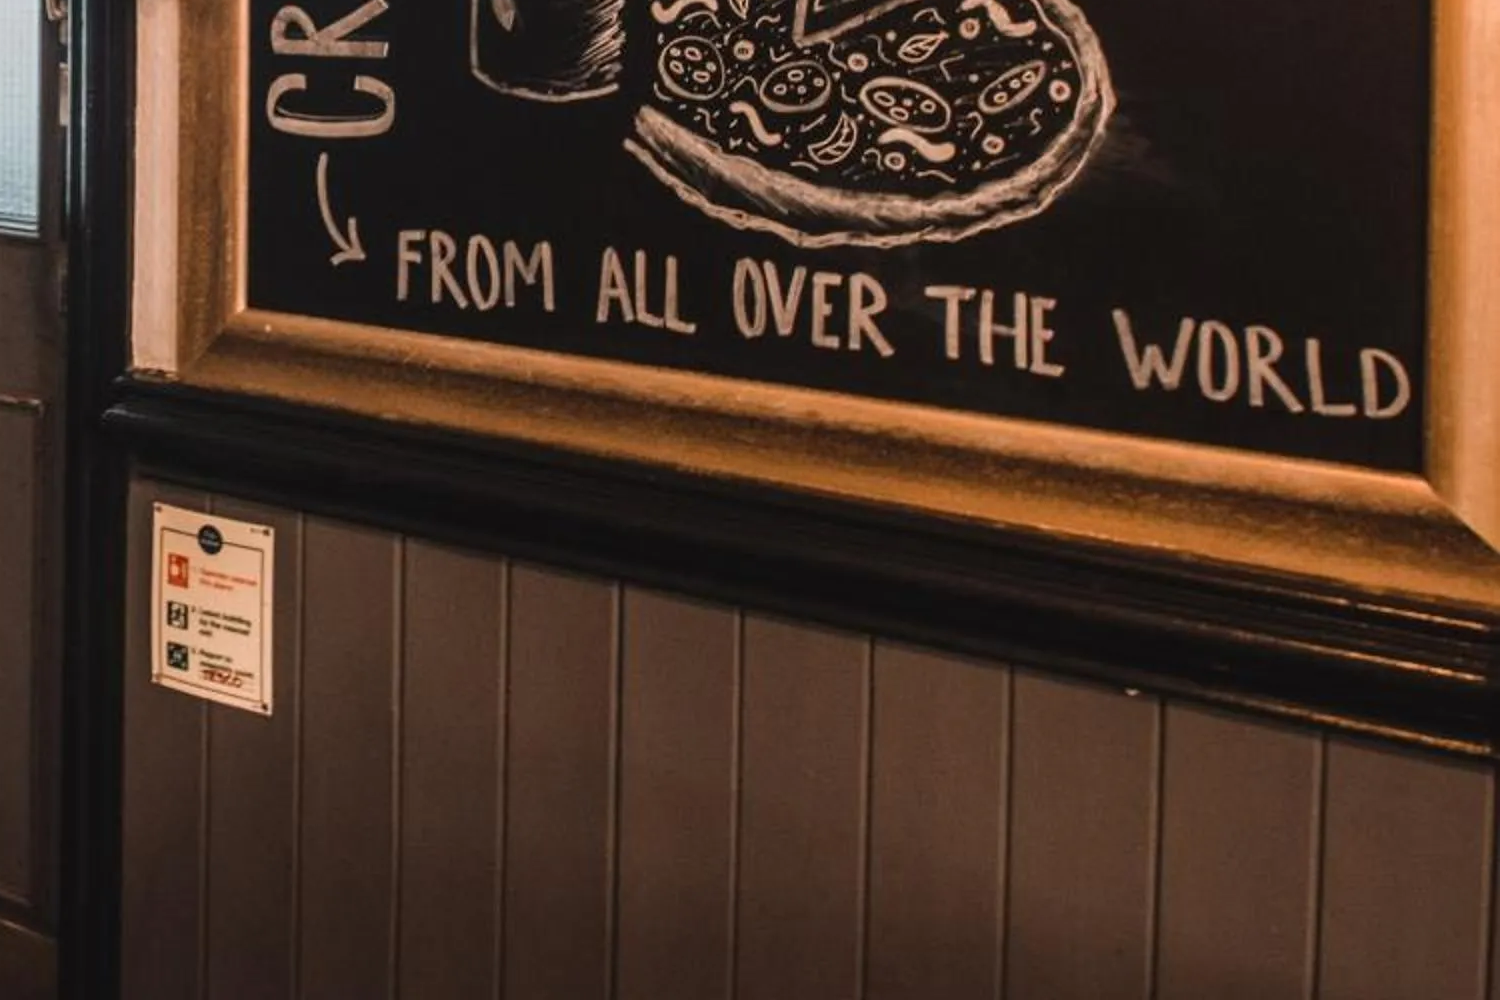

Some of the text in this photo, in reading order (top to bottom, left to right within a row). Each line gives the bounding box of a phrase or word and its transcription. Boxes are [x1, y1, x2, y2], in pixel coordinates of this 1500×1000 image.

[397, 229, 1411, 419] FROM ALL OVER THE WORLD
